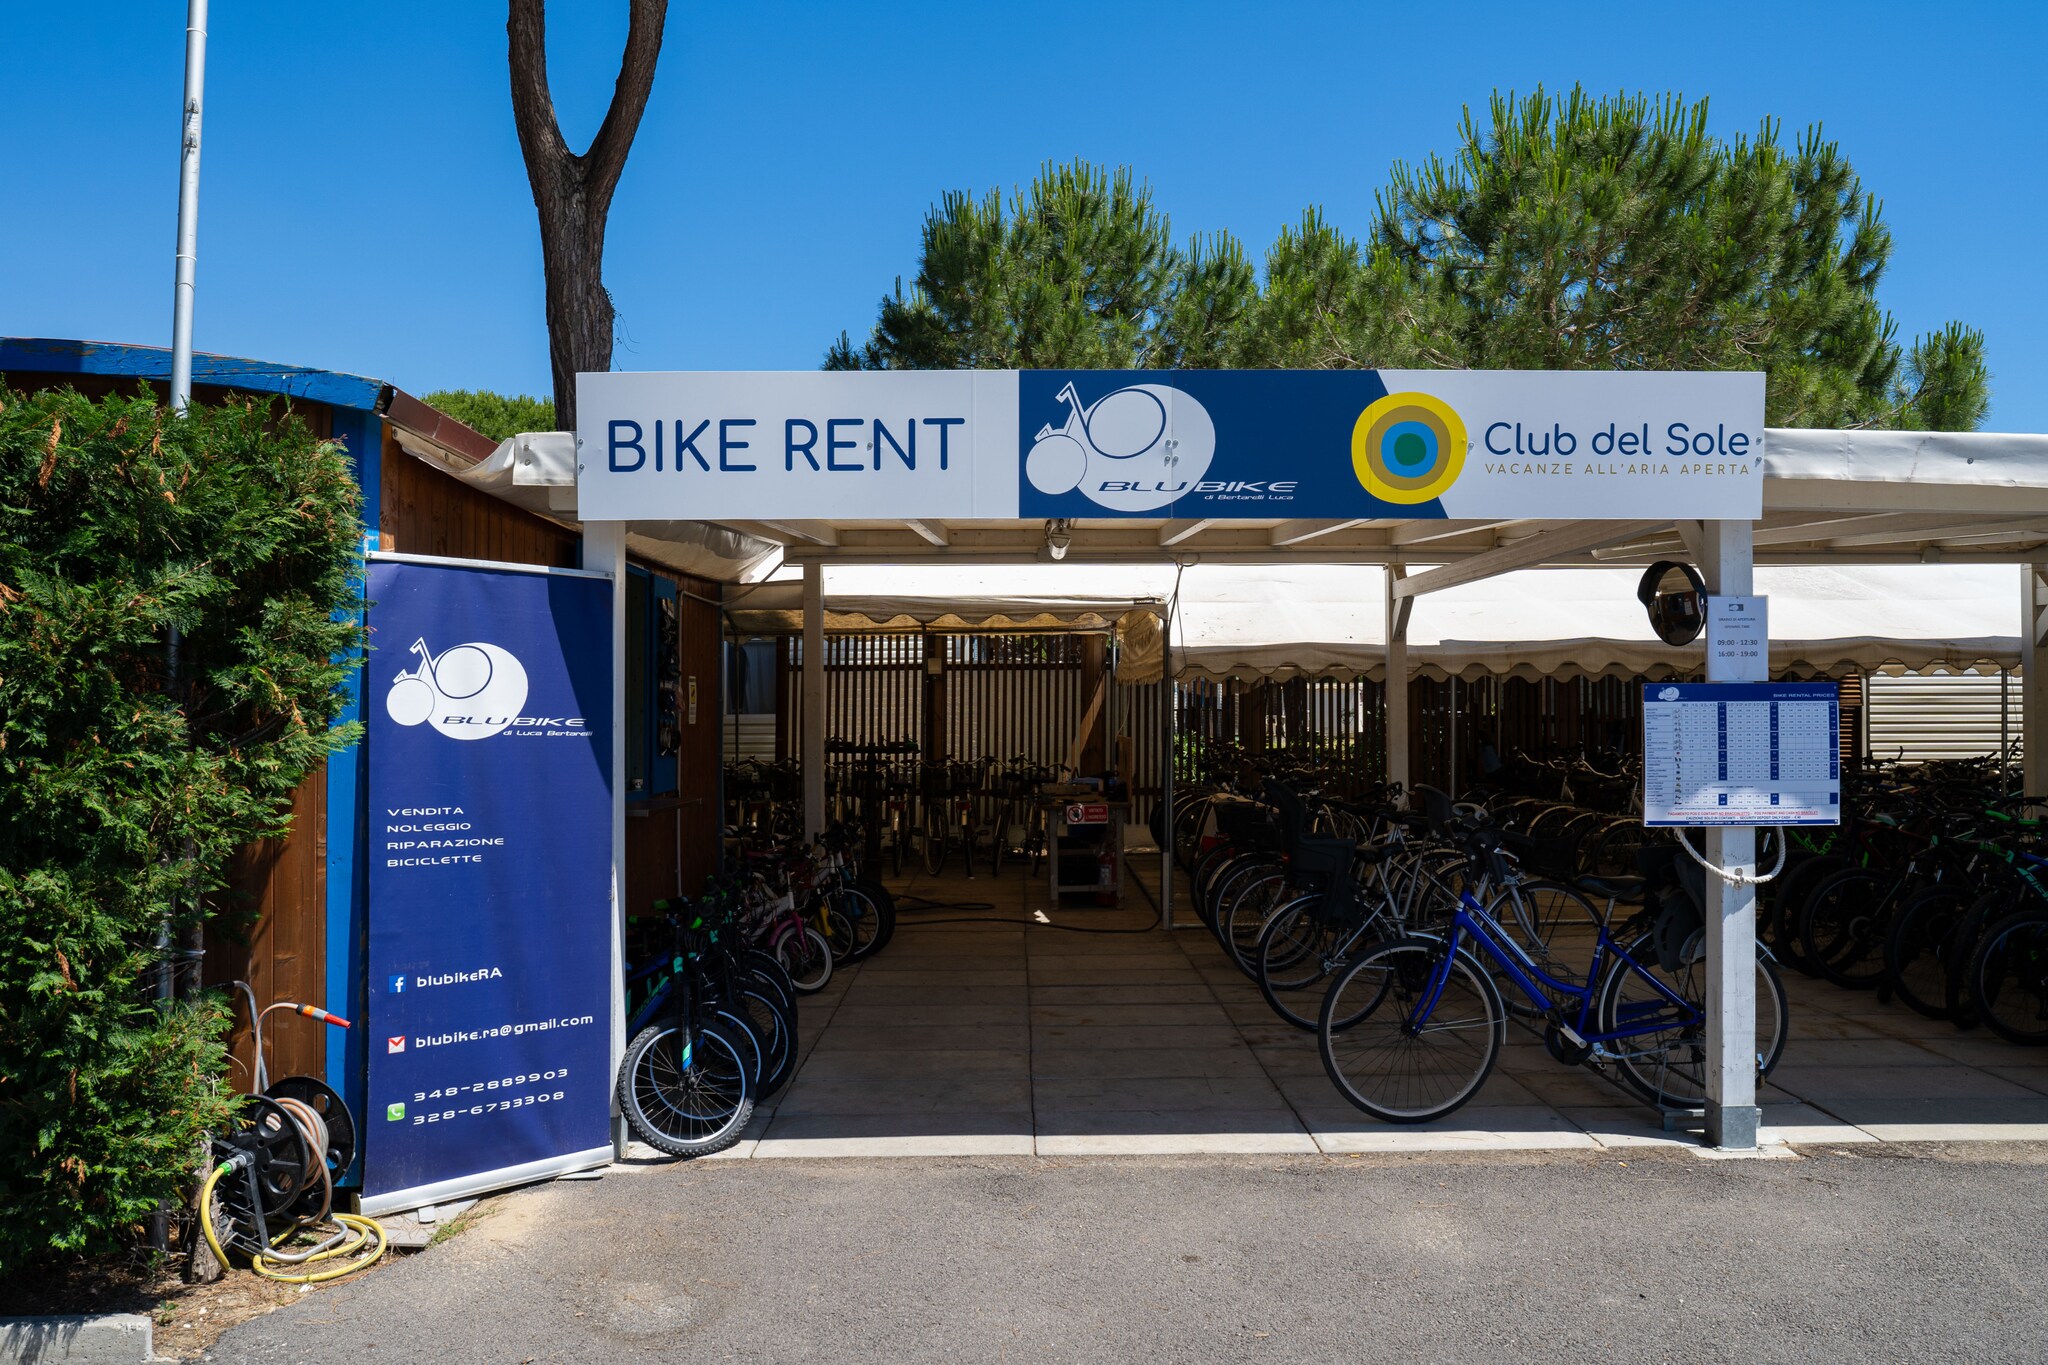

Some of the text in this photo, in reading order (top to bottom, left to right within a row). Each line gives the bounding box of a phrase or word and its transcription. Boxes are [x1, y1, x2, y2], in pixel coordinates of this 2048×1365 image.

[607, 417, 966, 472] BIKE RENT
[1483, 421, 1750, 456] Club del Sole
[1484, 463, 1750, 475] VACANZE ALL'ARIA APERTA
[387, 806, 464, 816] VENDITA
[387, 822, 471, 833] NOLEGGIO
[387, 838, 504, 850] RIPARAZIONE
[387, 854, 482, 868] BICICLETTE
[416, 967, 502, 988] blubikeRA
[415, 1015, 594, 1048] blubike.ra@gmail.com
[414, 1068, 568, 1102] 348-2889903
[412, 1091, 565, 1126] 328-6733308
